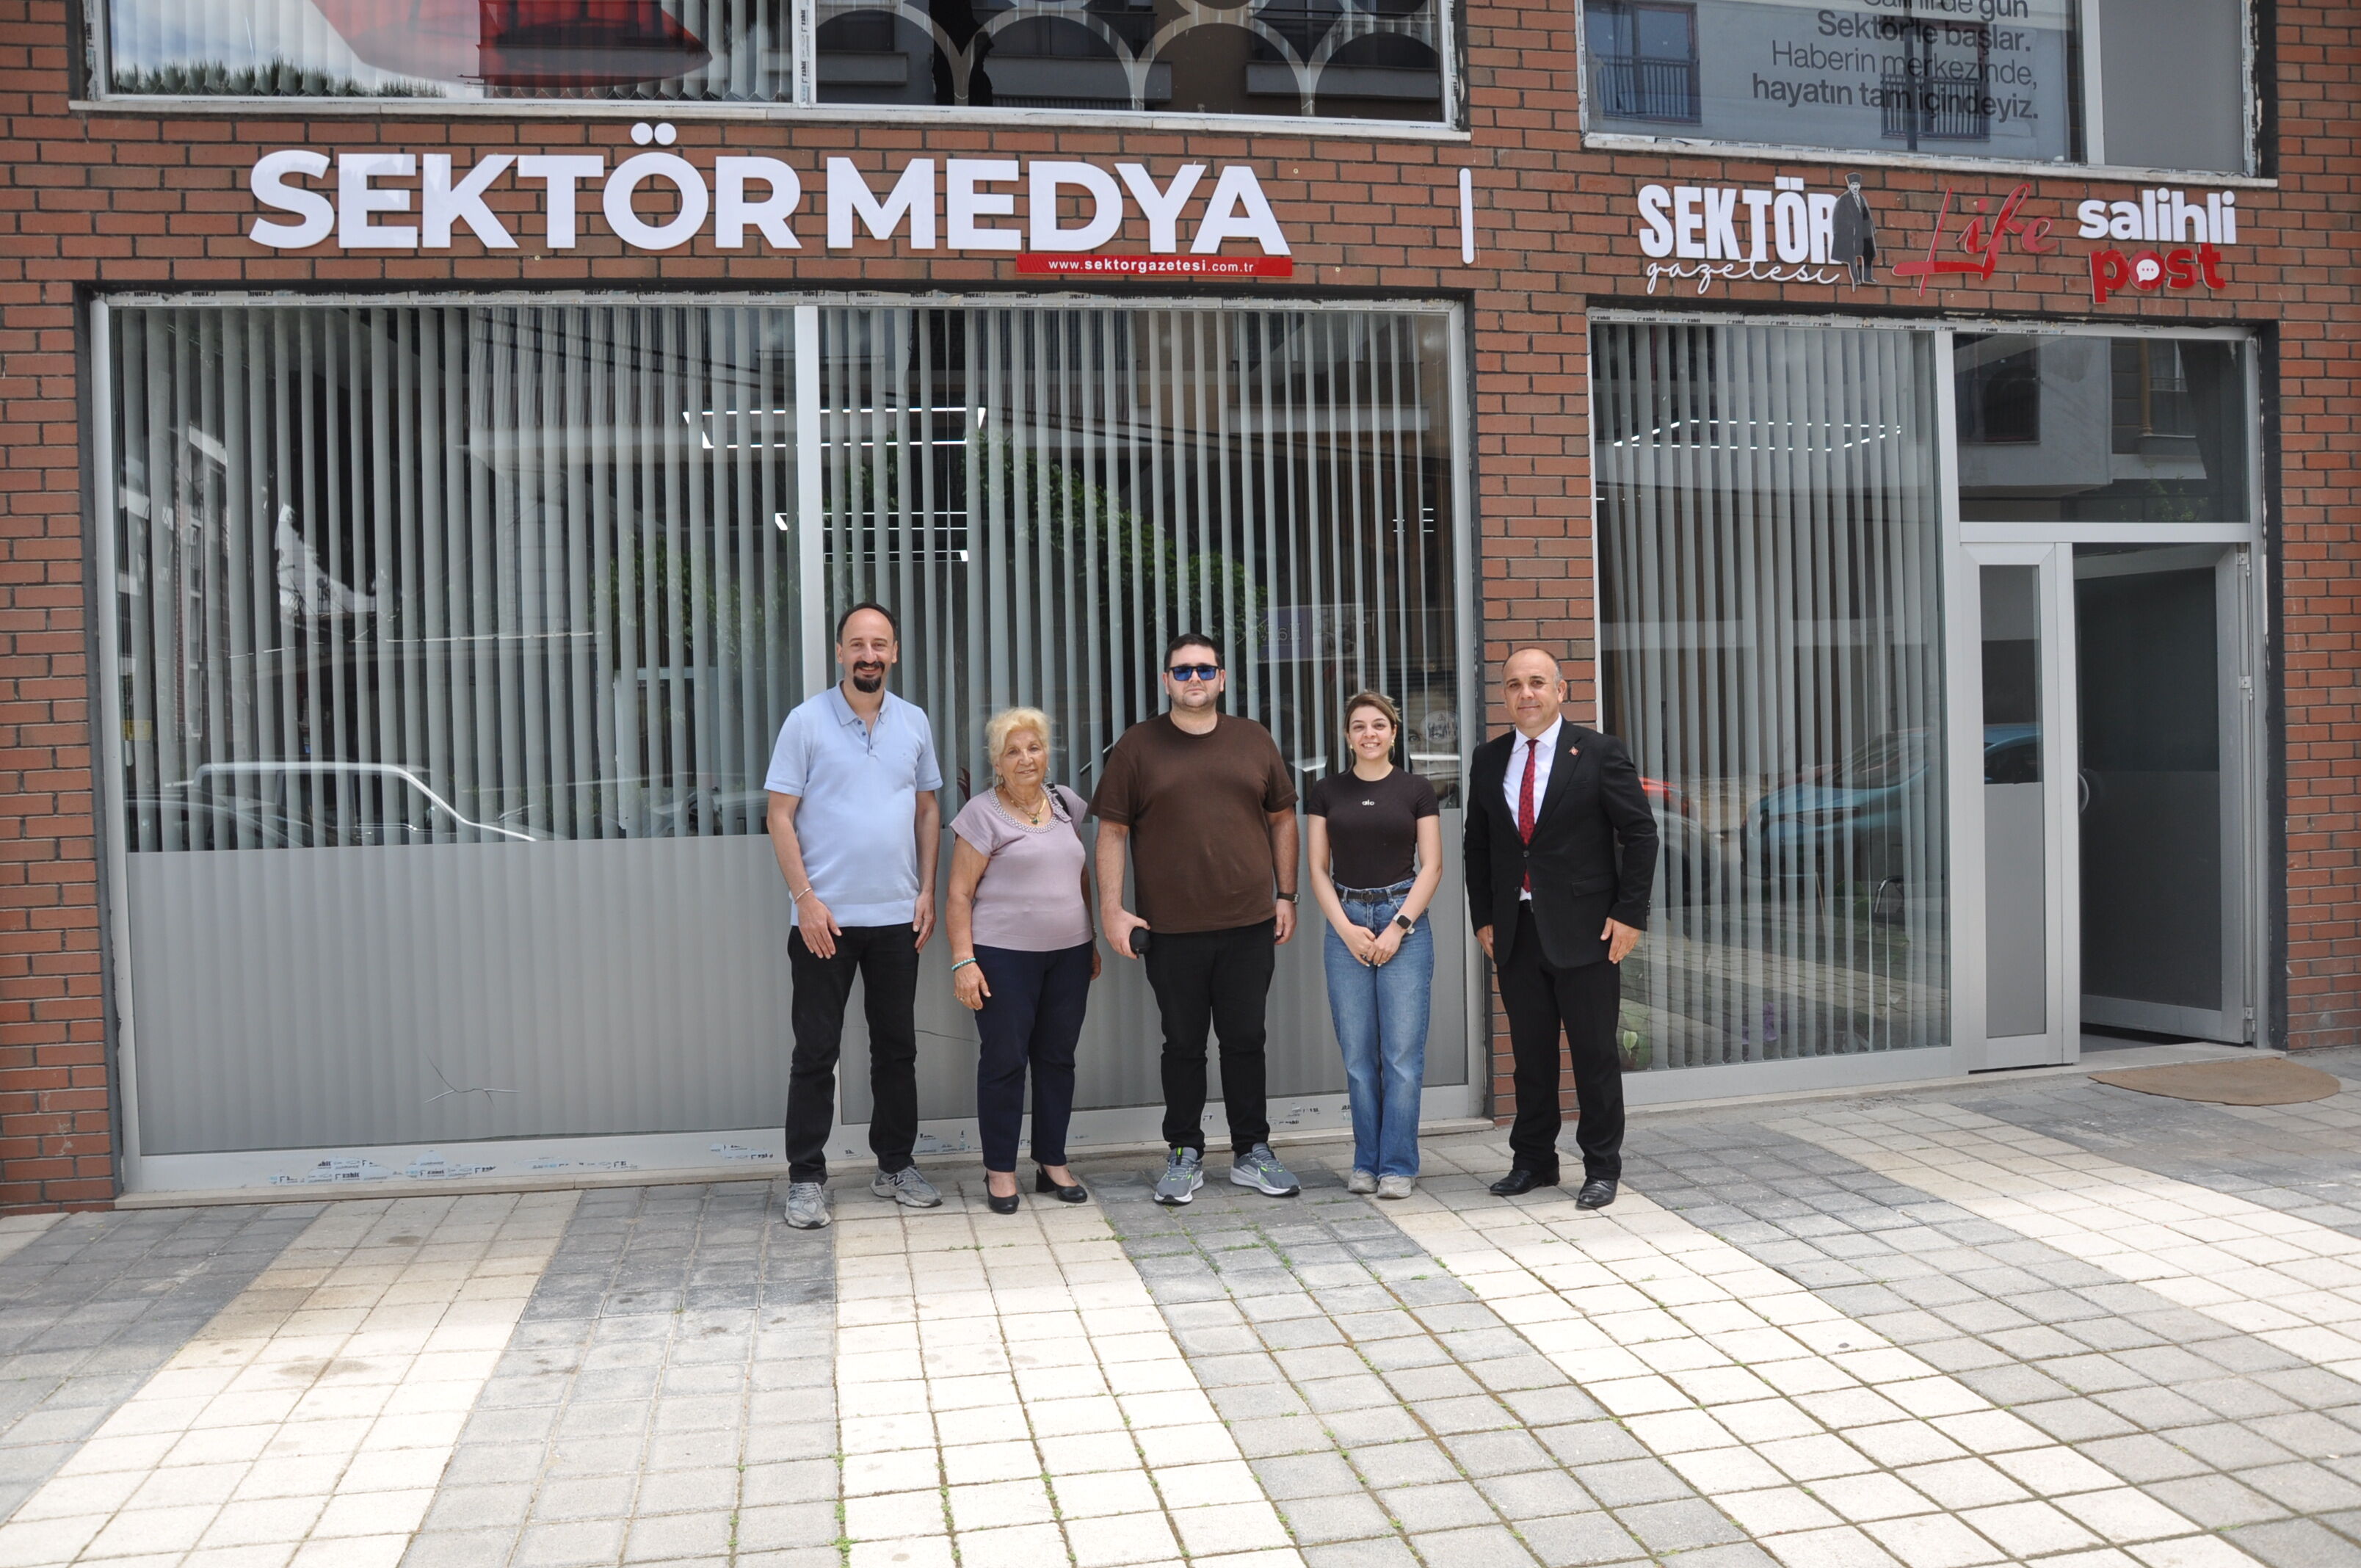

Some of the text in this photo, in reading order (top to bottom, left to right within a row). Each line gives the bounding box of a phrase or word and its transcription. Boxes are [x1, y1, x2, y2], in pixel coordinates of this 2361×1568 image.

[1772, 40, 2037, 90] Haberin merkezinde,
[1945, 21, 2031, 55] başlar.
[1752, 73, 2039, 123] hayatın tam içindeyiz.
[249, 122, 1291, 255] SEKTÖR MEDYA
[2077, 187, 2237, 244] salihli
[1637, 176, 1842, 264] SEKTÖR
[1891, 184, 2059, 297] Life
[1048, 258, 1254, 273] www.sektorgazetesi.com.tr
[2089, 242, 2226, 304] post
